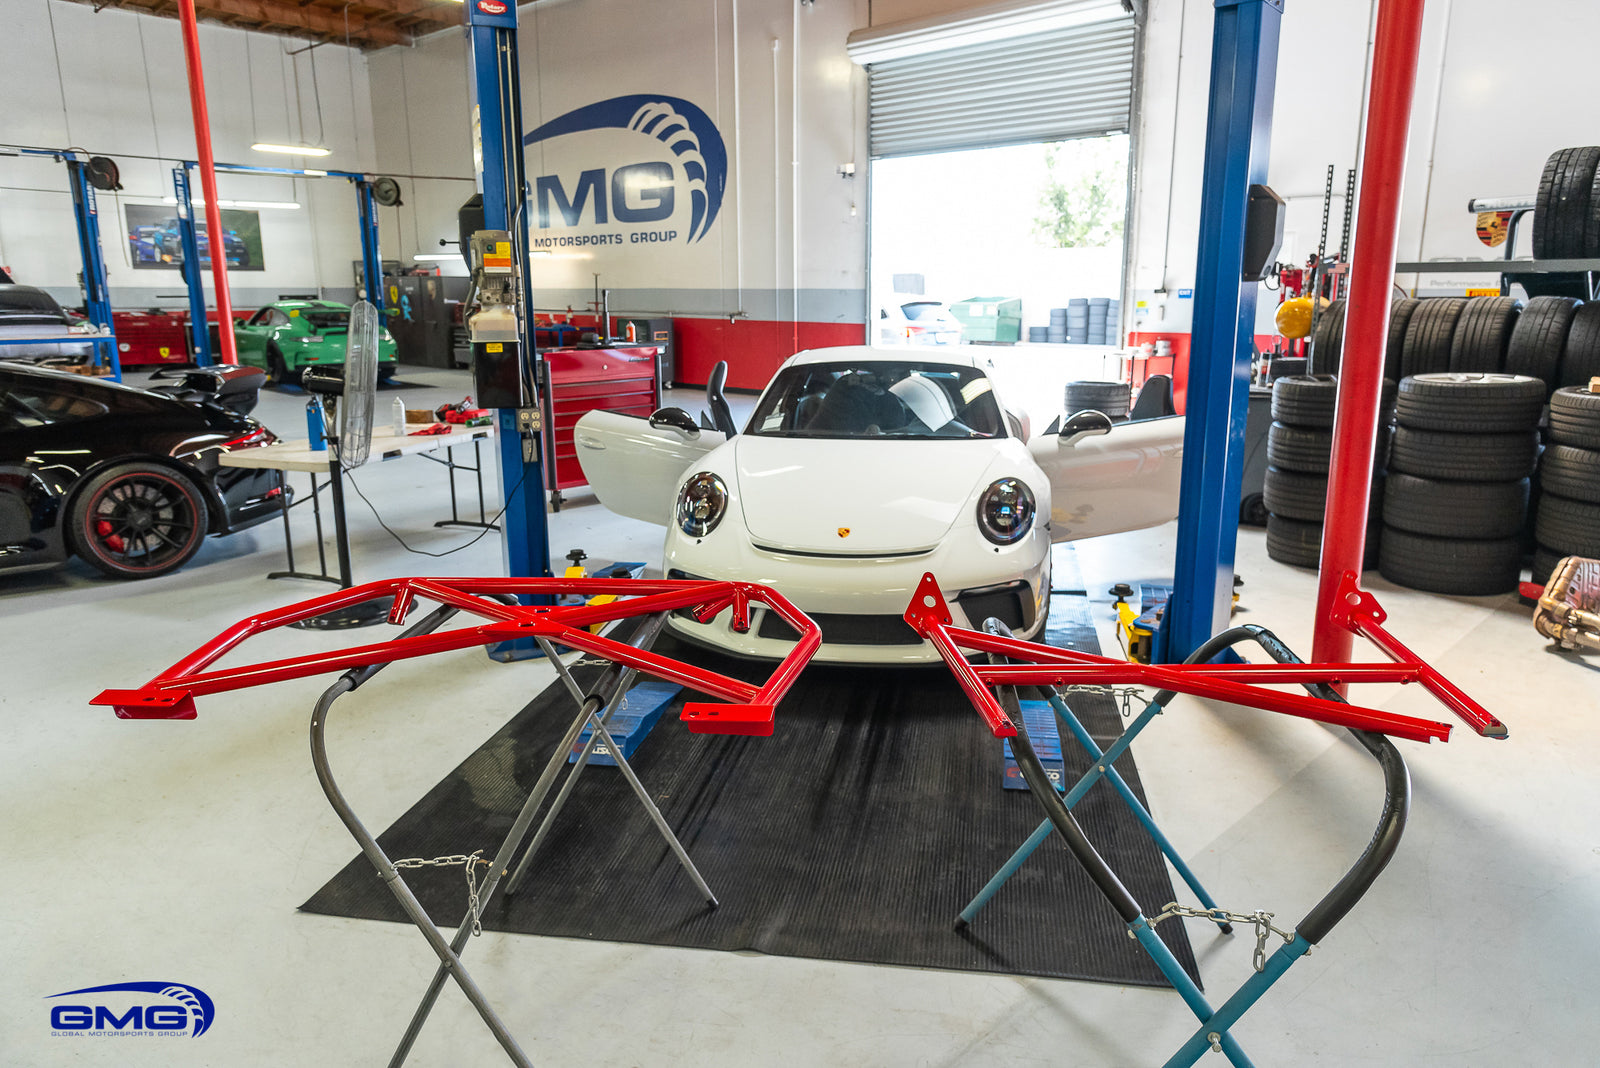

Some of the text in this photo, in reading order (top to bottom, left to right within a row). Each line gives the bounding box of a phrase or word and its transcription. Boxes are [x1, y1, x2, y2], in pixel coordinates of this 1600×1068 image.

[525, 161, 675, 229] MG
[535, 230, 677, 248] MOTORSPORTS GROUP
